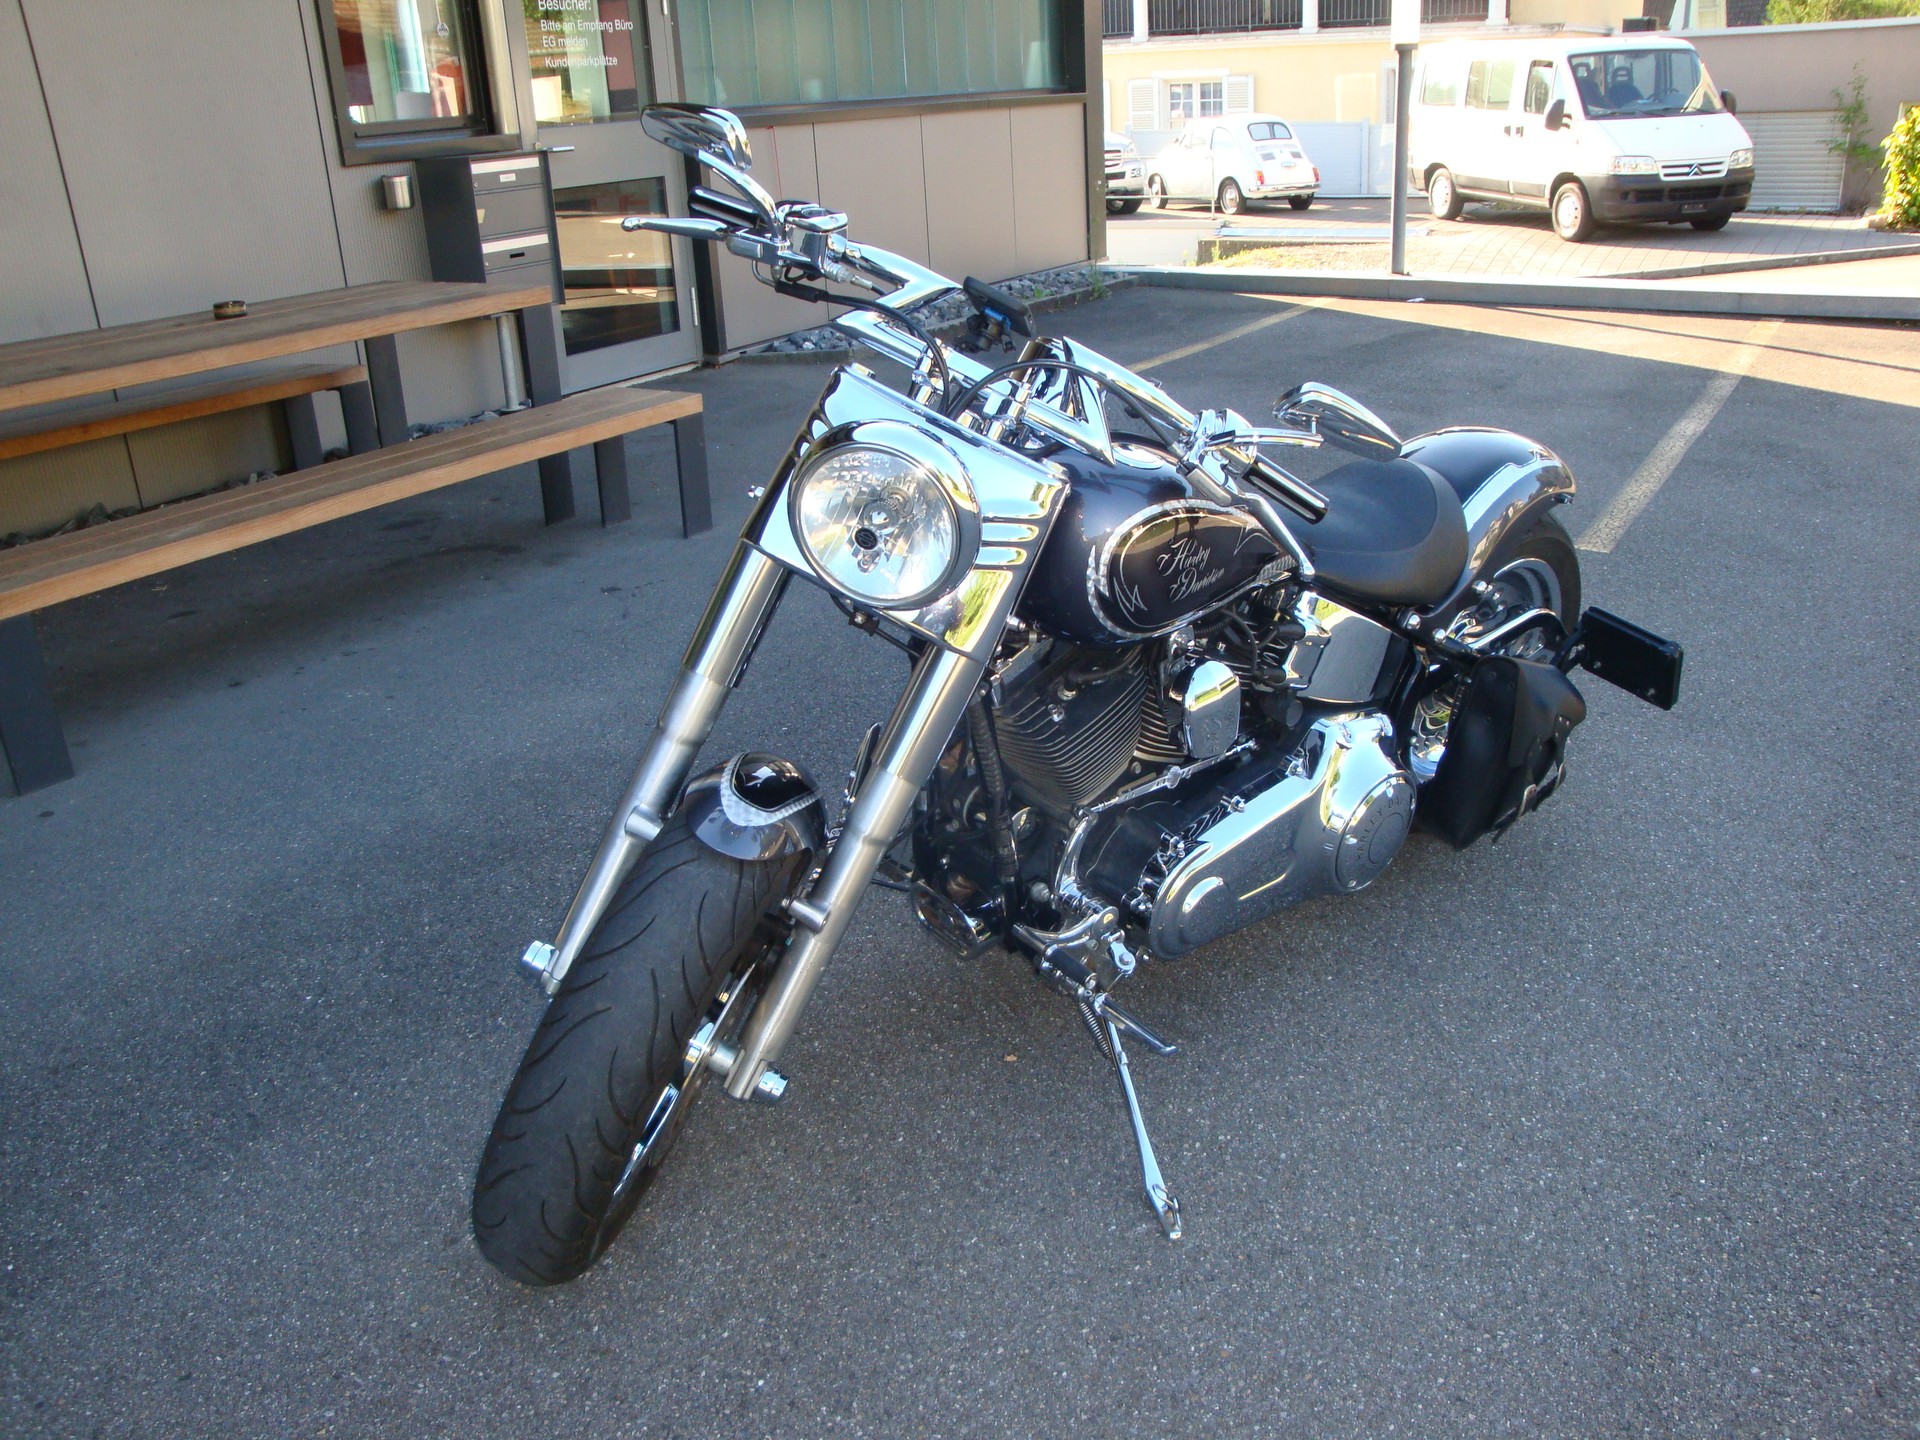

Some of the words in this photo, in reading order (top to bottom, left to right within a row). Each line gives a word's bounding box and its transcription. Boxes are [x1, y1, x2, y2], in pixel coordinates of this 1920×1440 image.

[538, 0, 592, 10] Besucher:
[540, 20, 561, 32] Bitte
[563, 22, 576, 31] am
[577, 20, 613, 33] Empfang
[614, 19, 634, 31] Büro
[542, 35, 556, 48] EG
[558, 36, 588, 47] melden
[545, 55, 618, 69] Kundenparkplätze
[1156, 537, 1211, 577] Harley
[1169, 567, 1225, 603] Davidson
